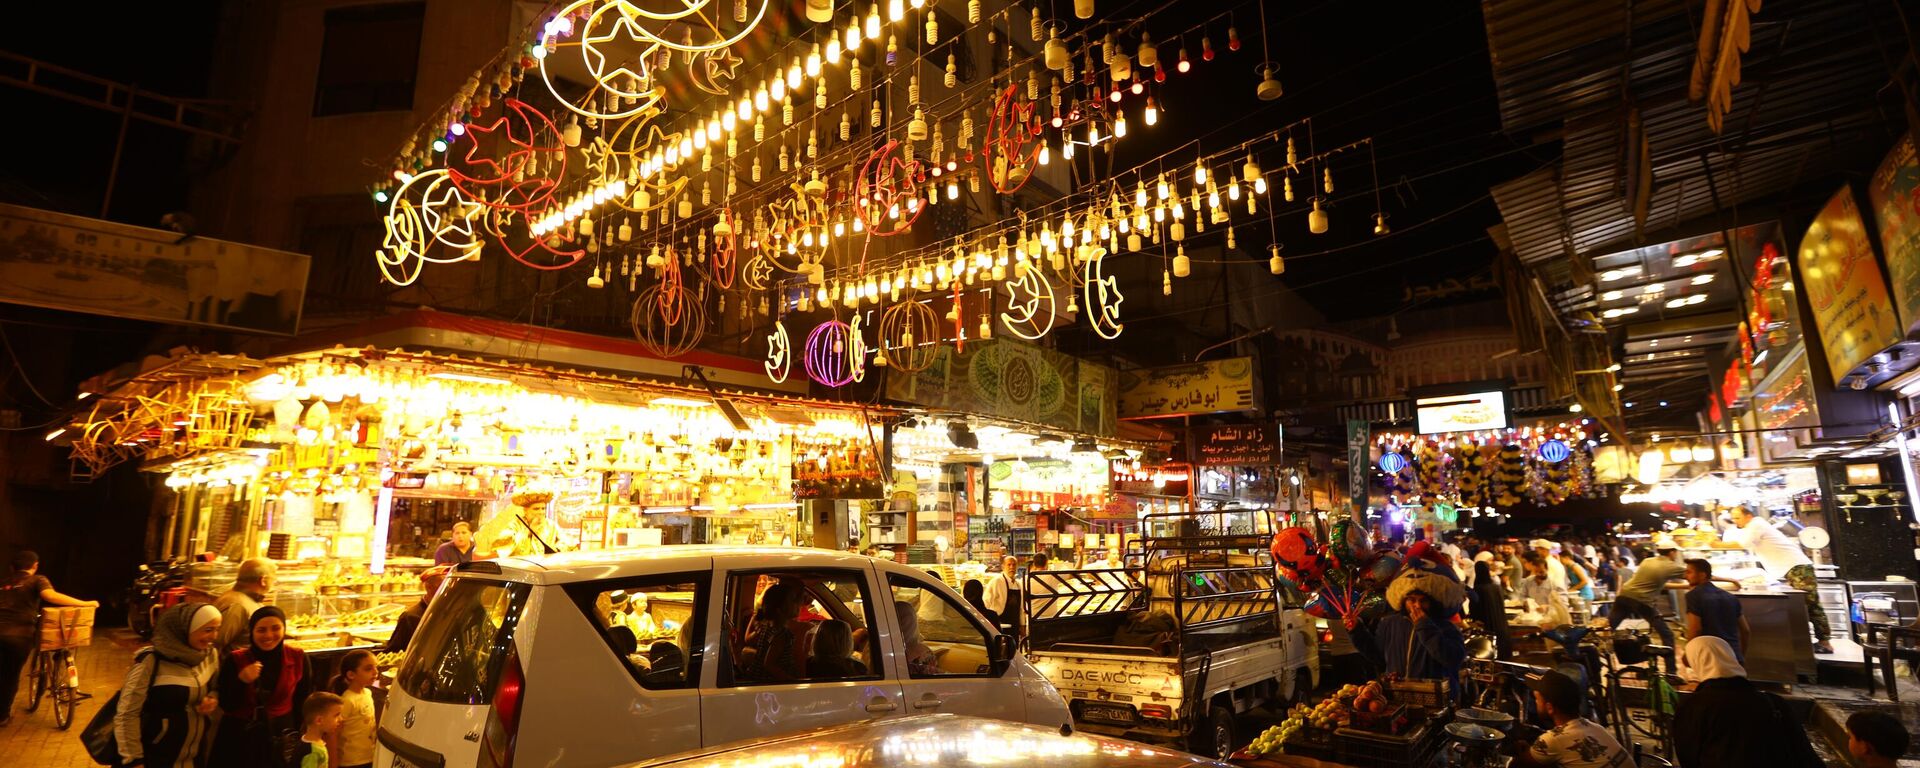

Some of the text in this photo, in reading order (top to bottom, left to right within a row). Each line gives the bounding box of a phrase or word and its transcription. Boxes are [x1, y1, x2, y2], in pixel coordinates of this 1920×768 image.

[1139, 385, 1220, 412] أبو فارس حيدر
[1211, 427, 1264, 444] زاد الشام
[1205, 456, 1221, 464] حيدر
[1349, 427, 1366, 498] بن الحموي
